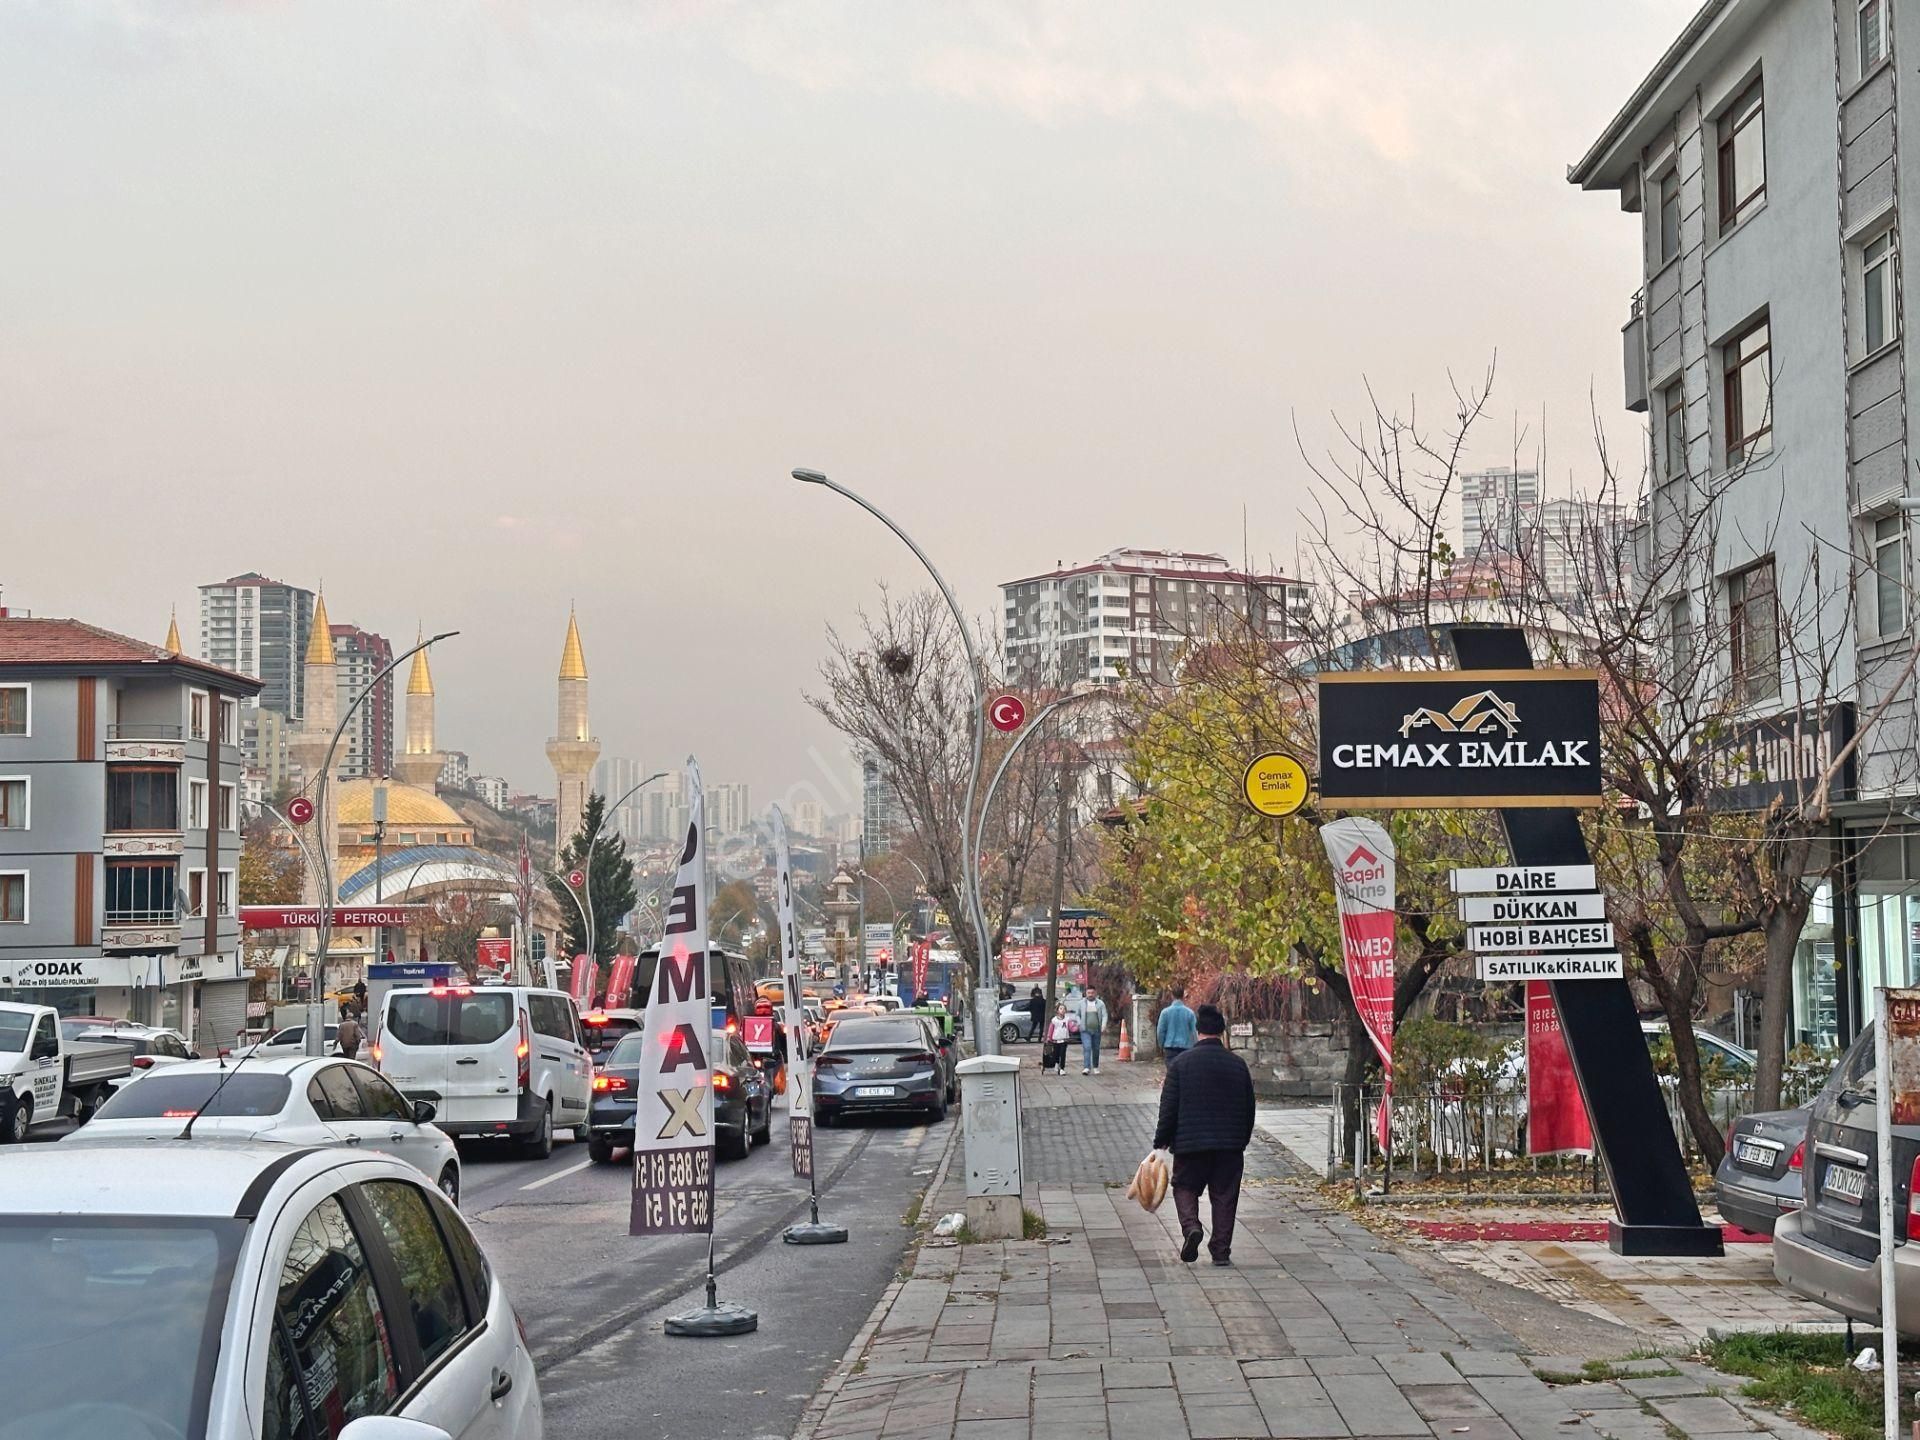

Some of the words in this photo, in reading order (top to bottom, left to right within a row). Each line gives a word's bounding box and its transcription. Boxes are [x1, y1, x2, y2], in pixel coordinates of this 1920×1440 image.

[1332, 743, 1452, 768] CEMAX
[1458, 740, 1591, 768] EMLAK
[1258, 771, 1294, 780] Cemax
[1261, 781, 1292, 790] Emlak
[1496, 868, 1557, 890] DAİRE
[281, 911, 336, 924] TÜRKİE
[344, 912, 411, 924] PETROLLE
[1493, 898, 1578, 920] DÜKKAN
[1479, 926, 1523, 946] HOBİ
[1529, 923, 1609, 948] BAHÇESİ
[34, 962, 83, 976] ODAK
[1489, 958, 1617, 975] SATILIK&KİRALIK
